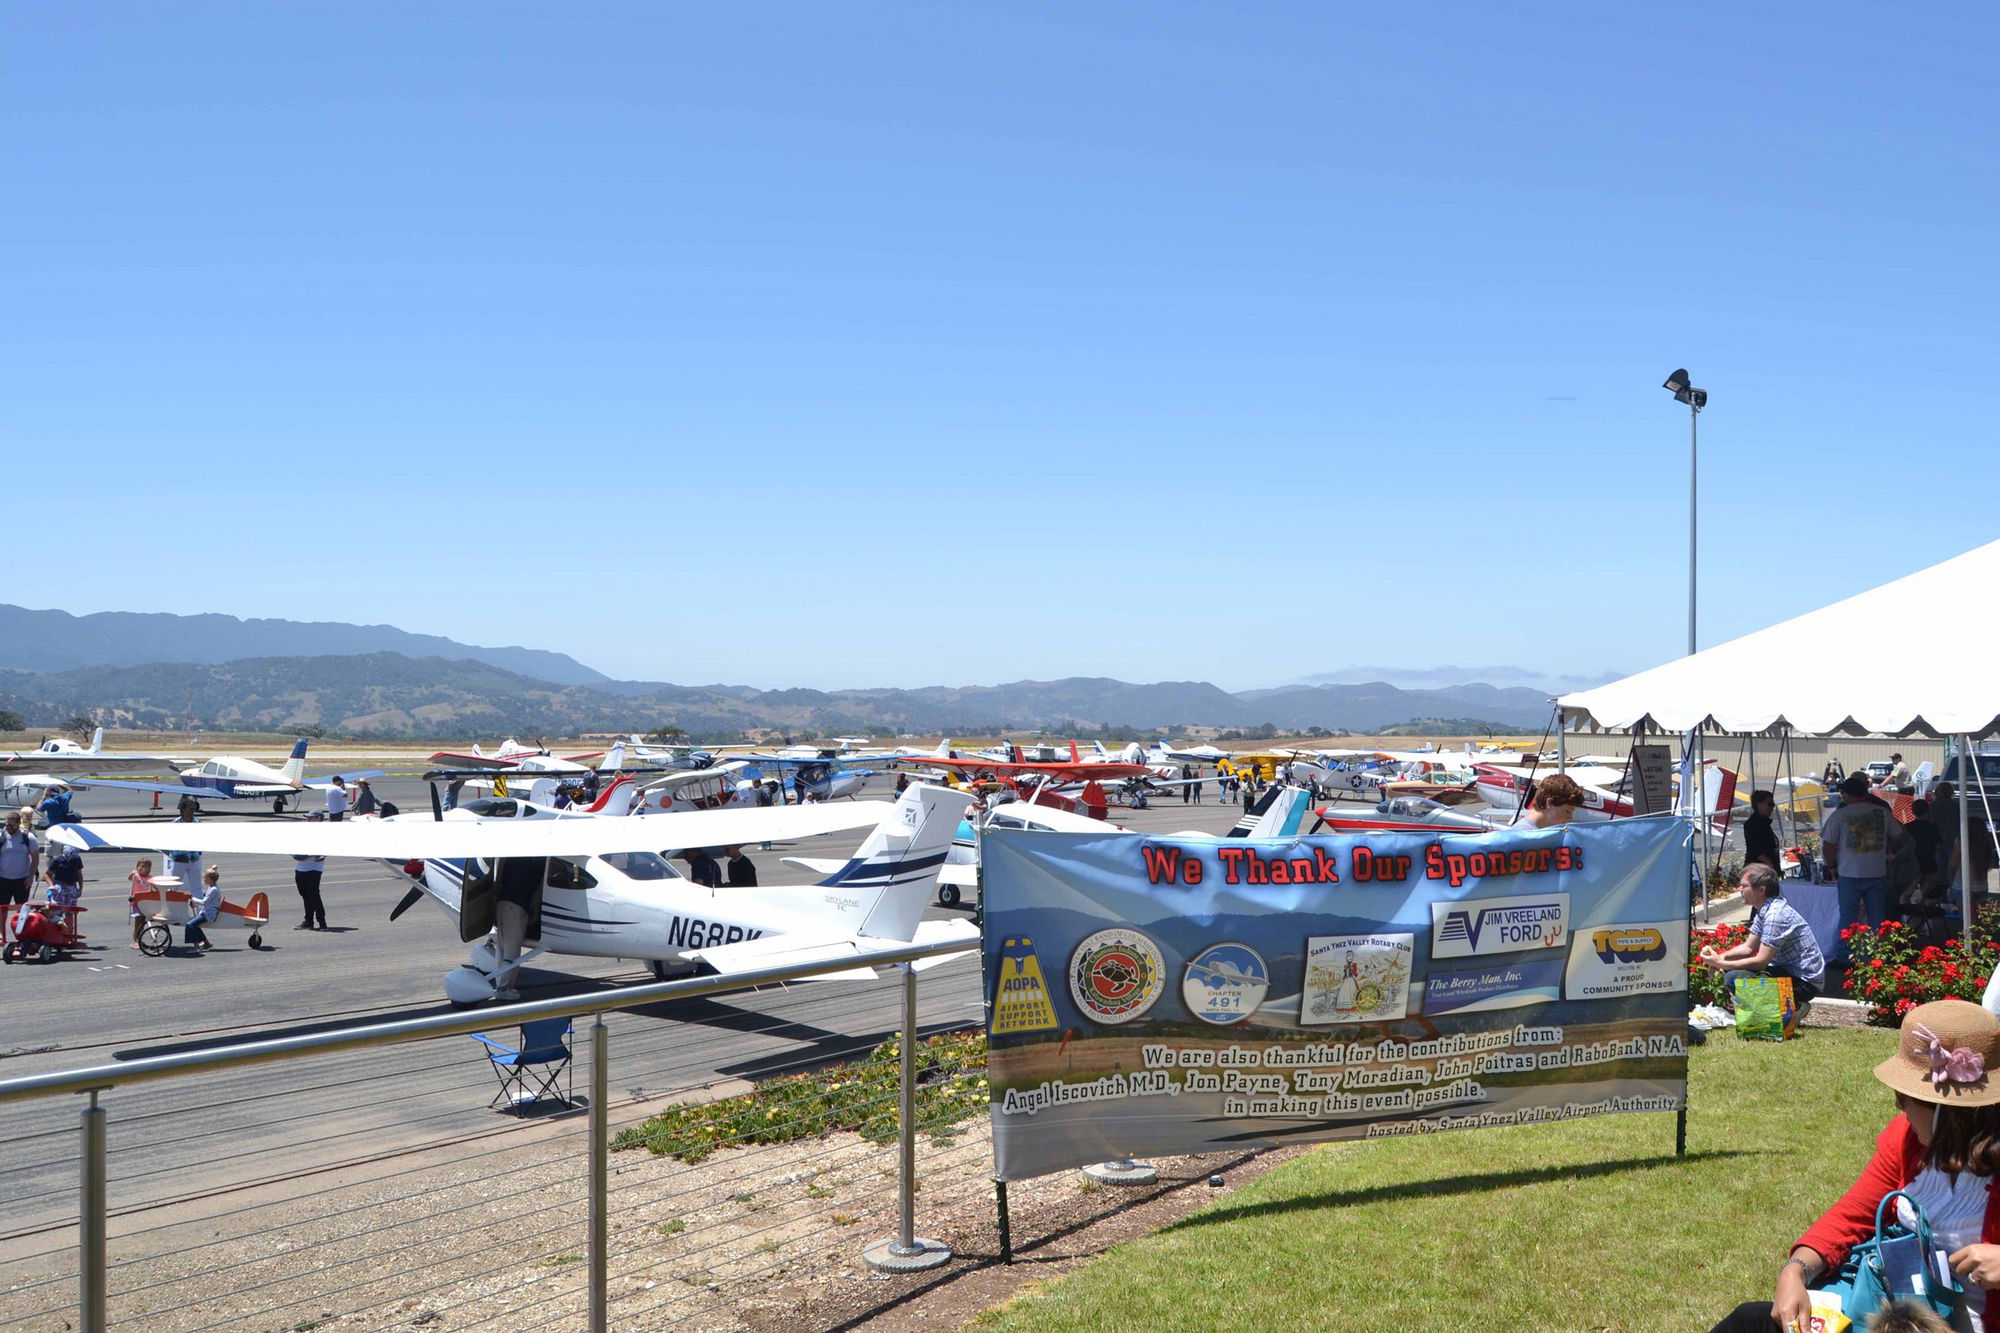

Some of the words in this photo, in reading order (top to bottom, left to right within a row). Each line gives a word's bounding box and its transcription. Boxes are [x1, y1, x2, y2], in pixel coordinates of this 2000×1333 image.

[1142, 847, 1203, 885] We
[1218, 847, 1339, 884] Thank
[1352, 846, 1411, 882] Our
[1425, 844, 1584, 887] Sponsors:
[1485, 912, 1502, 925] JIM
[1504, 908, 1562, 924] VREELAND
[1500, 924, 1542, 944] FORD
[1592, 928, 1664, 958] TODD
[1310, 946, 1330, 957] SANTA
[1331, 941, 1346, 950] YNEZ
[1347, 939, 1370, 947] VALLEY
[1371, 938, 1395, 948] ROTARY
[1396, 942, 1411, 953] CLUB
[1003, 976, 1040, 992] AOPA
[1430, 979, 1448, 990] The
[1450, 977, 1477, 989] Berry
[1505, 971, 1522, 982] Inc.
[1583, 985, 1633, 994] COMMUNITY
[1635, 981, 1673, 990] SPONSOR
[1000, 1002, 1045, 1012] AIRPORT
[1208, 997, 1240, 1007] 491
[1000, 1010, 1047, 1021] SUPPORT
[1000, 1018, 1050, 1029] NETWORK
[1146, 1048, 1173, 1064] We
[1182, 1053, 1212, 1064] are
[1221, 1049, 1258, 1064] also
[1266, 1047, 1341, 1064] thankful
[1349, 1048, 1372, 1061] for
[1380, 1043, 1404, 1058] the
[1412, 1032, 1511, 1056] contributions
[1516, 1026, 1561, 1043] from:
[1006, 1087, 1048, 1110] Angel
[1055, 1078, 1124, 1101] Iscovich
[1132, 1074, 1178, 1092] M.D.,
[1188, 1074, 1217, 1088] Jon
[1226, 1074, 1287, 1092] Payne,
[1297, 1074, 1339, 1092] Tony
[1346, 1068, 1429, 1085] Moradian,
[1437, 1061, 1469, 1078] John
[1475, 1055, 1533, 1071] Poitras
[1541, 1052, 1568, 1066] and
[1573, 1040, 1643, 1063] RaboBank
[1650, 1038, 1686, 1054] N.A.
[1227, 1100, 1244, 1113] in
[1253, 1098, 1318, 1115] making
[1326, 1095, 1358, 1111] this
[1366, 1092, 1410, 1108] event
[1417, 1082, 1484, 1104] possible.
[1369, 1124, 1414, 1137] hosted
[1440, 1120, 1476, 1131] Santa
[1483, 1114, 1512, 1125] Ynez
[1519, 1110, 1558, 1122] Valley
[1564, 1104, 1608, 1118] Airport
[1612, 1098, 1675, 1111] Authority
